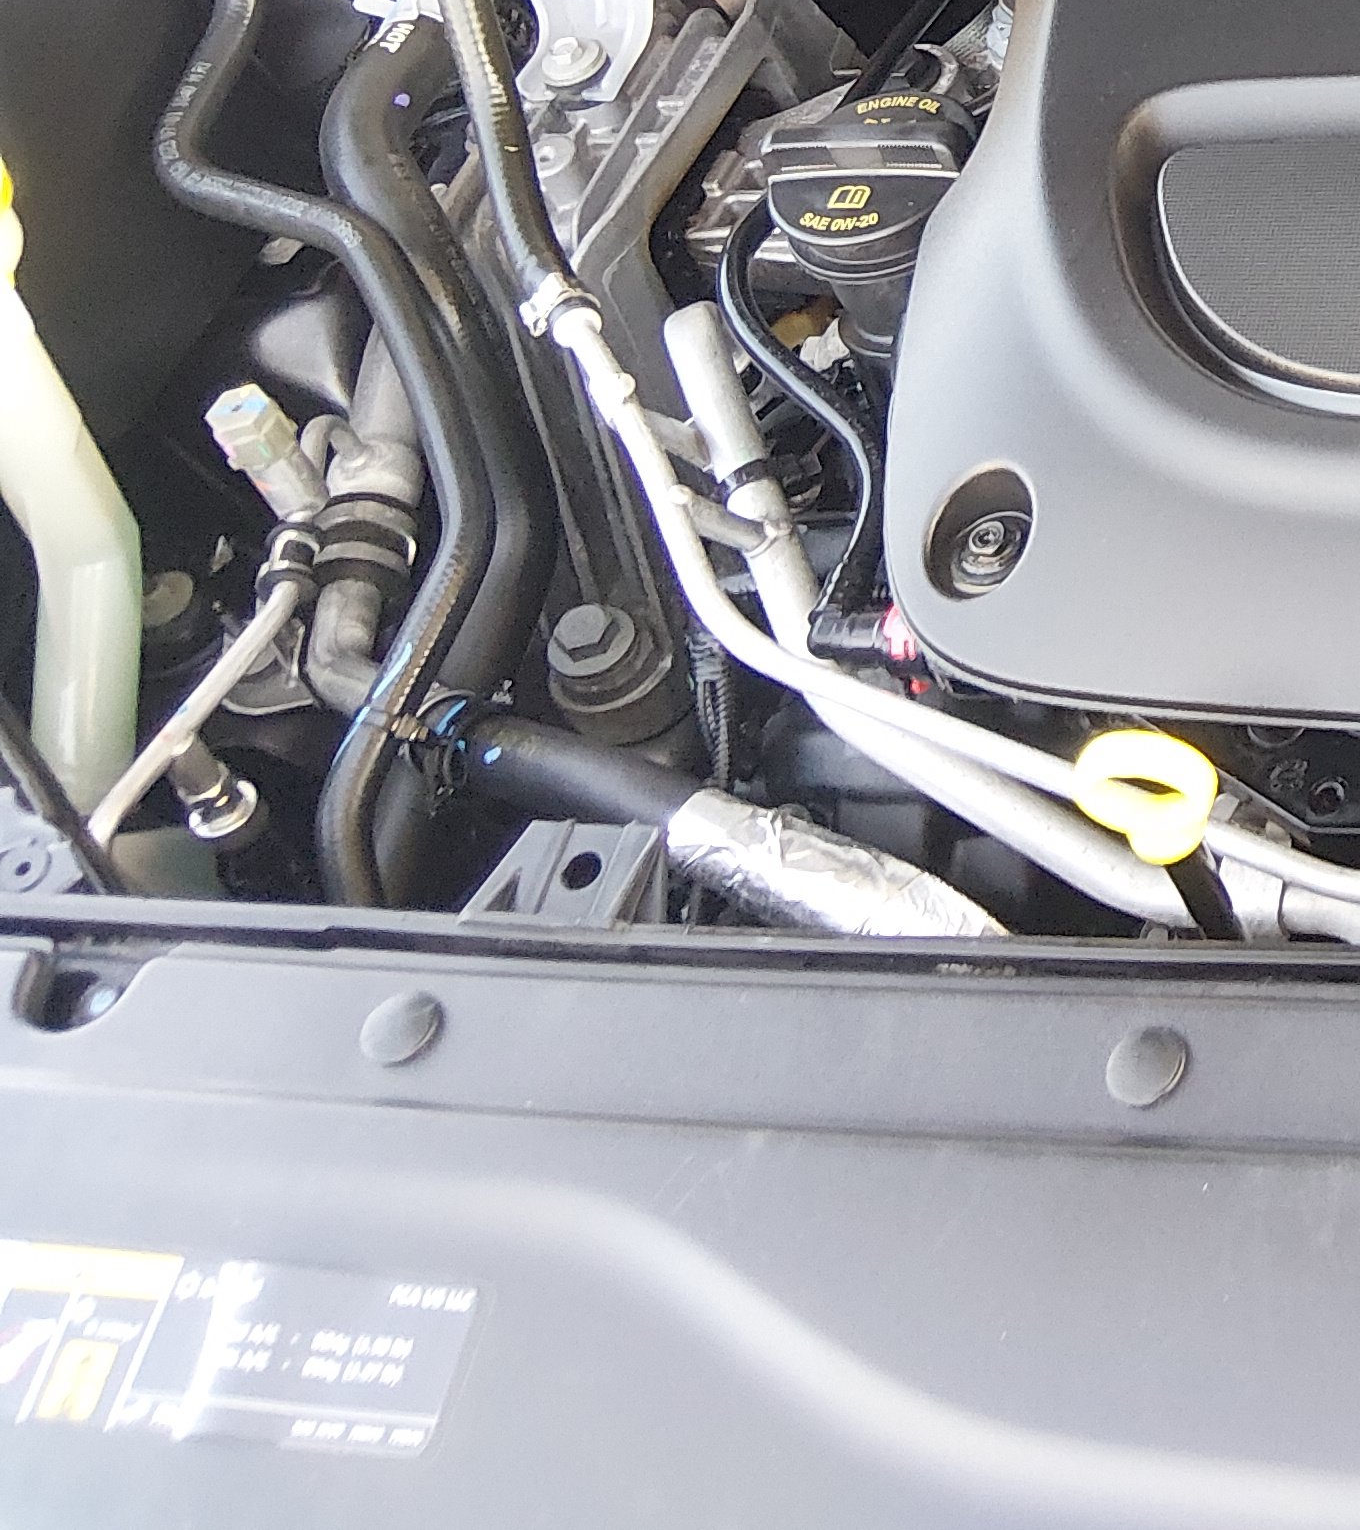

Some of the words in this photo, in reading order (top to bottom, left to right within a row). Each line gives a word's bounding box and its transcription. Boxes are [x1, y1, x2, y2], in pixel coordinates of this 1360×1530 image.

[379, 21, 415, 53] HOT
[856, 96, 919, 115] ENGINE
[918, 98, 942, 115] OIL
[800, 212, 832, 231] SAE
[831, 212, 879, 232] 0W-20
